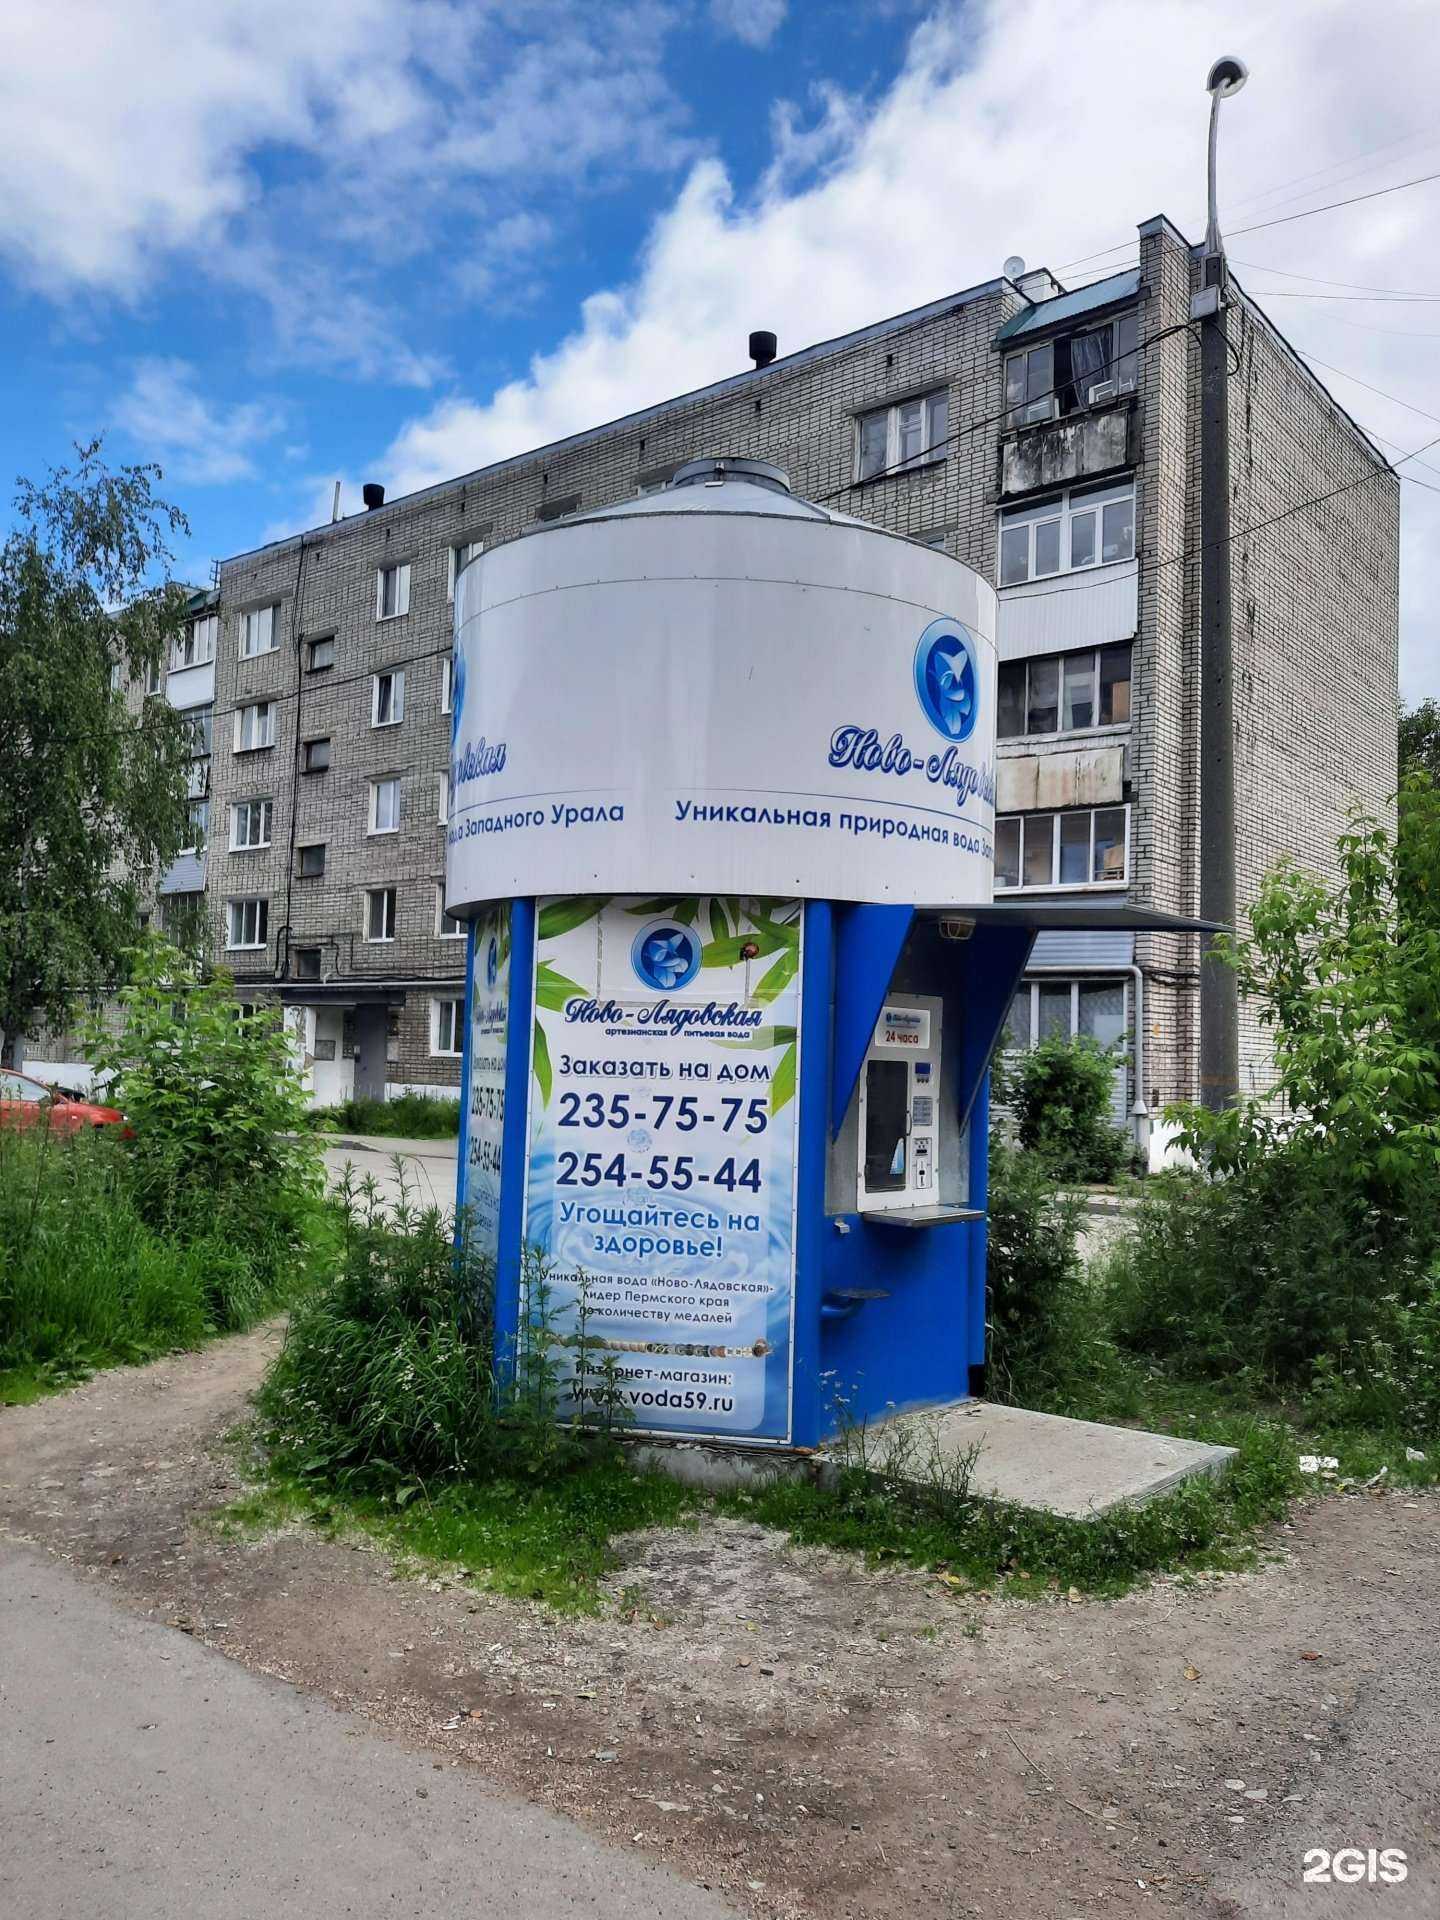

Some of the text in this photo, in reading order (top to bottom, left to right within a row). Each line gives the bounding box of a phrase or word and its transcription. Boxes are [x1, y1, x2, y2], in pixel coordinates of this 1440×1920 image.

[465, 808, 545, 839] Западного
[551, 803, 624, 828] Урала
[674, 800, 831, 828] Уникальная
[839, 813, 949, 845] природная
[564, 998, 763, 1036] Ново-Лядовская
[727, 1031, 751, 1039] вода
[558, 1054, 771, 1082] Заказать на дом
[557, 1092, 768, 1134] 235-75-75
[556, 1151, 762, 1194] 254-55-44
[559, 1201, 760, 1232] Угощайтесь на
[594, 1234, 723, 1258] здоровье!
[617, 1277, 648, 1287] вода
[625, 1291, 695, 1306] Пермского
[699, 1297, 730, 1308] края
[598, 1308, 671, 1322] количеству
[674, 1311, 732, 1324] медалей
[575, 1364, 733, 1386] Интрнет-магазин:
